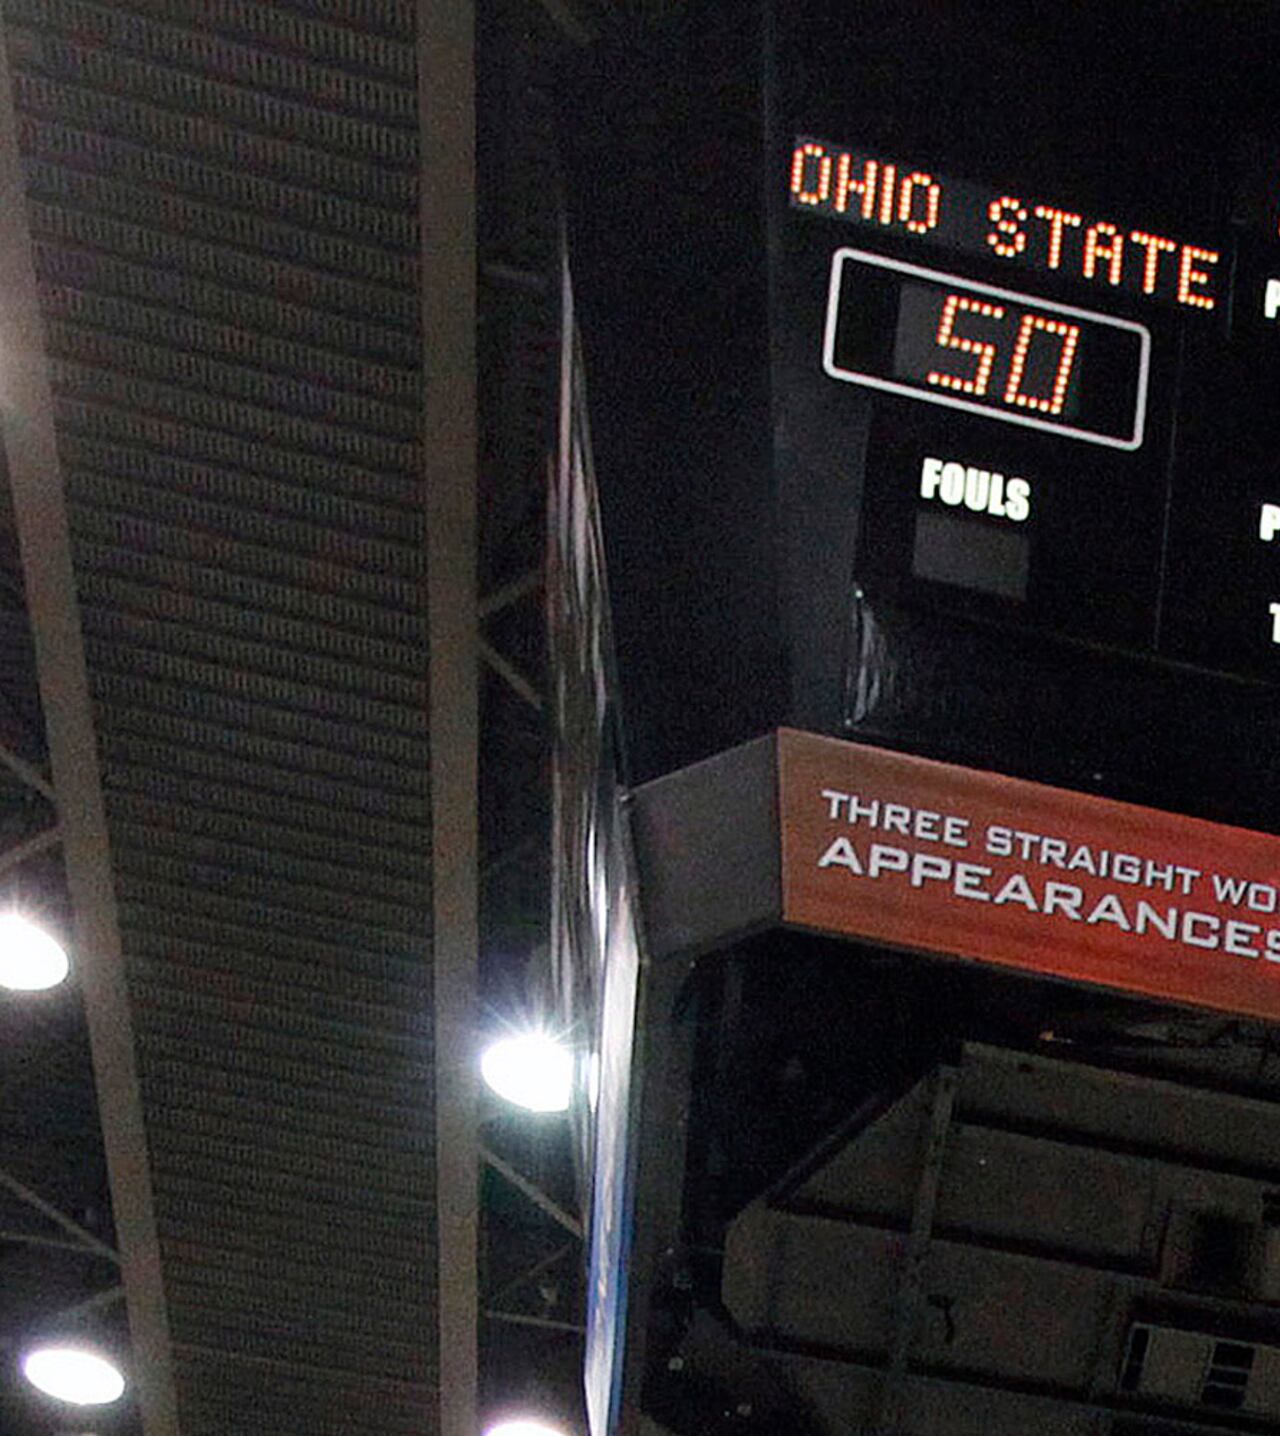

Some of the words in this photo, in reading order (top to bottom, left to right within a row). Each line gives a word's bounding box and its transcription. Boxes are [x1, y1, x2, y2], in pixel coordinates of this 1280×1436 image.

[790, 143, 940, 233] OHIO
[988, 195, 1220, 309] STATE
[926, 295, 1080, 414] 50
[919, 456, 1032, 522] FOULS
[821, 788, 970, 850] THREE
[983, 823, 1203, 896] STRAIGHT
